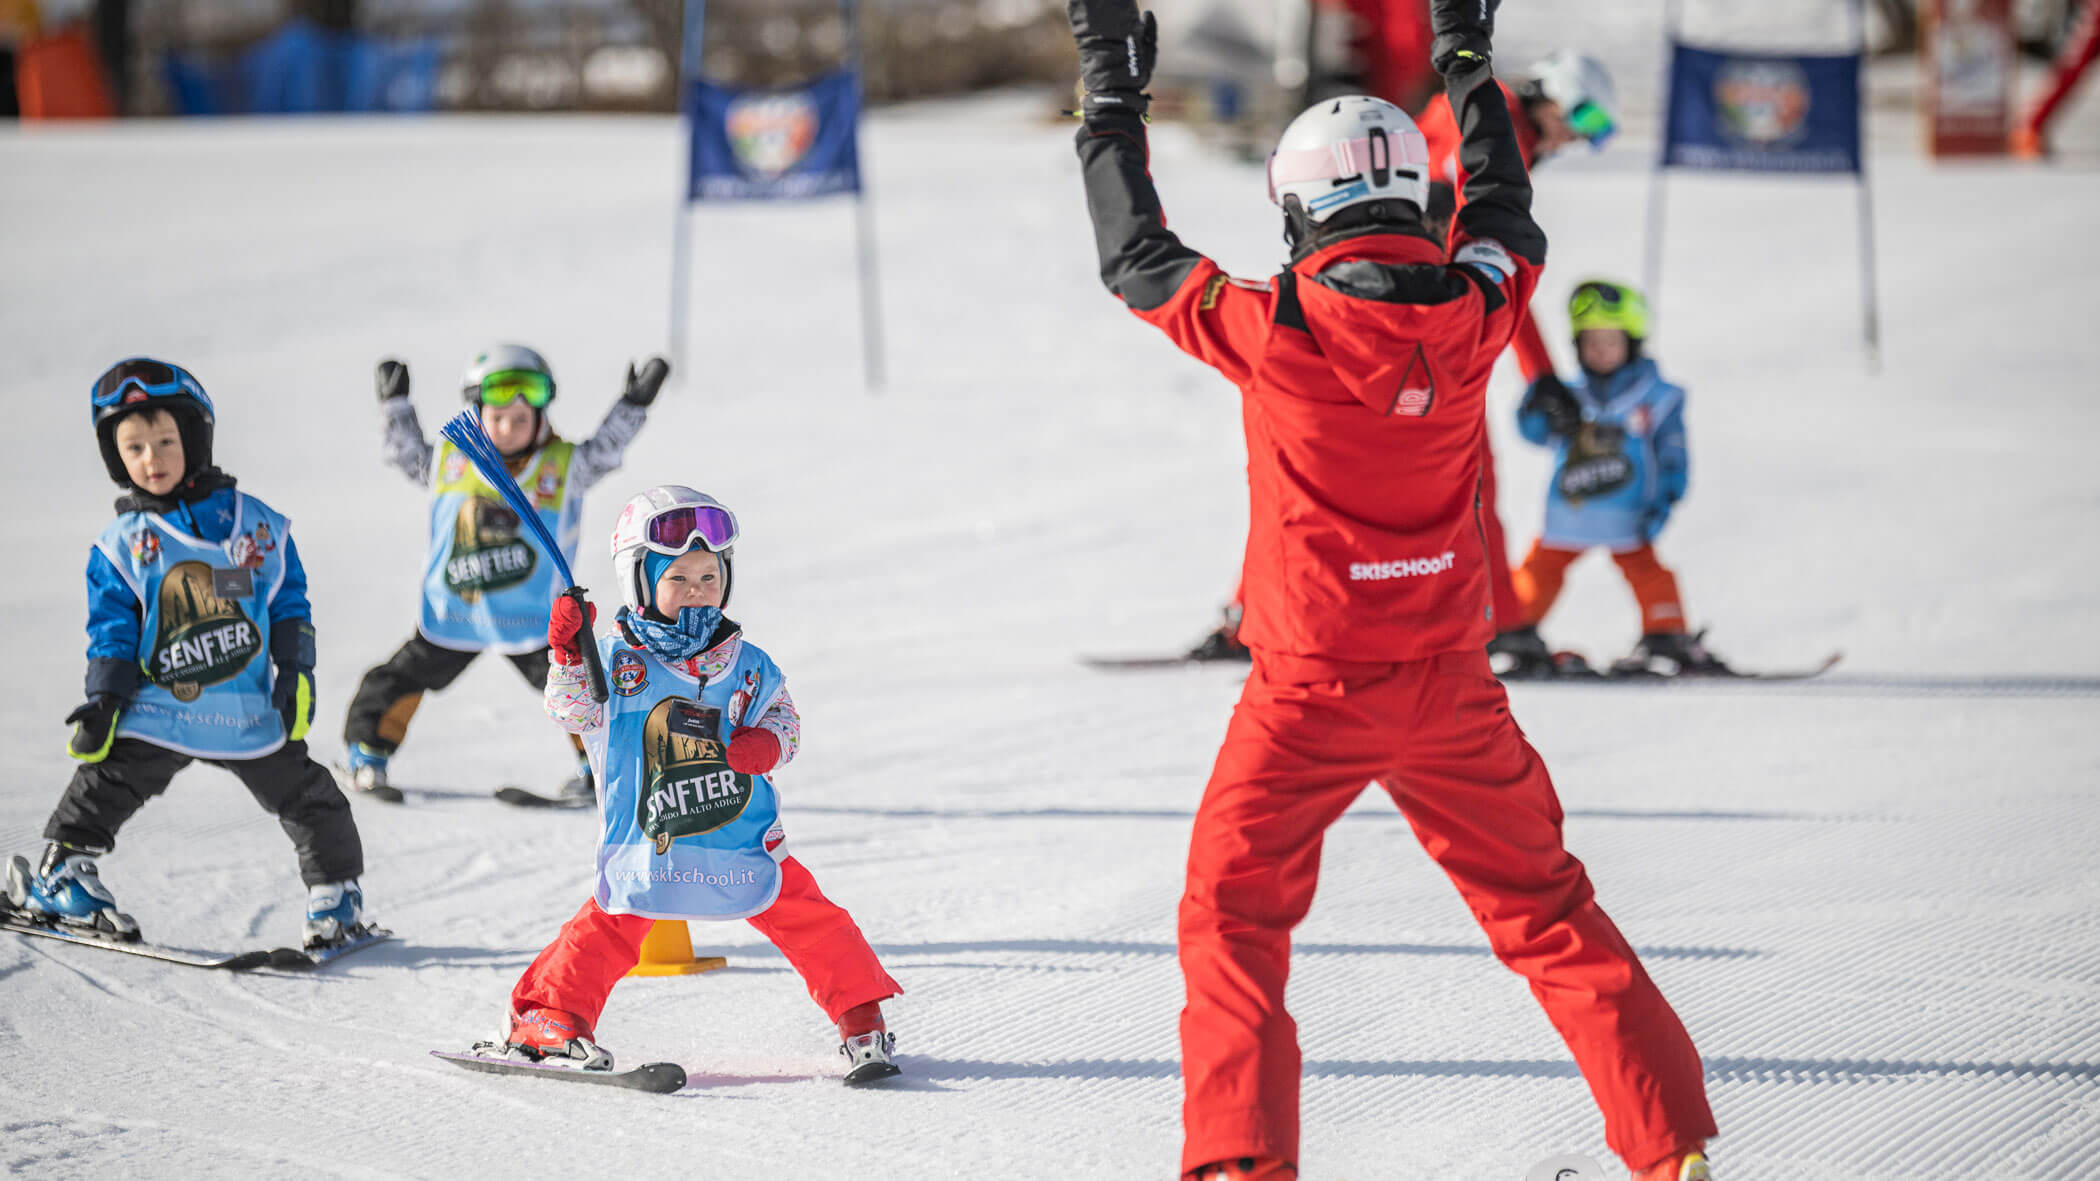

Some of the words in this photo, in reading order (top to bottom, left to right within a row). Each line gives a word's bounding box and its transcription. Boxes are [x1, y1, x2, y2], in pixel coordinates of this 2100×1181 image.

[158, 621, 251, 673] SENFTER
[689, 803, 712, 815] ALTO
[713, 796, 742, 809] ADIGE
